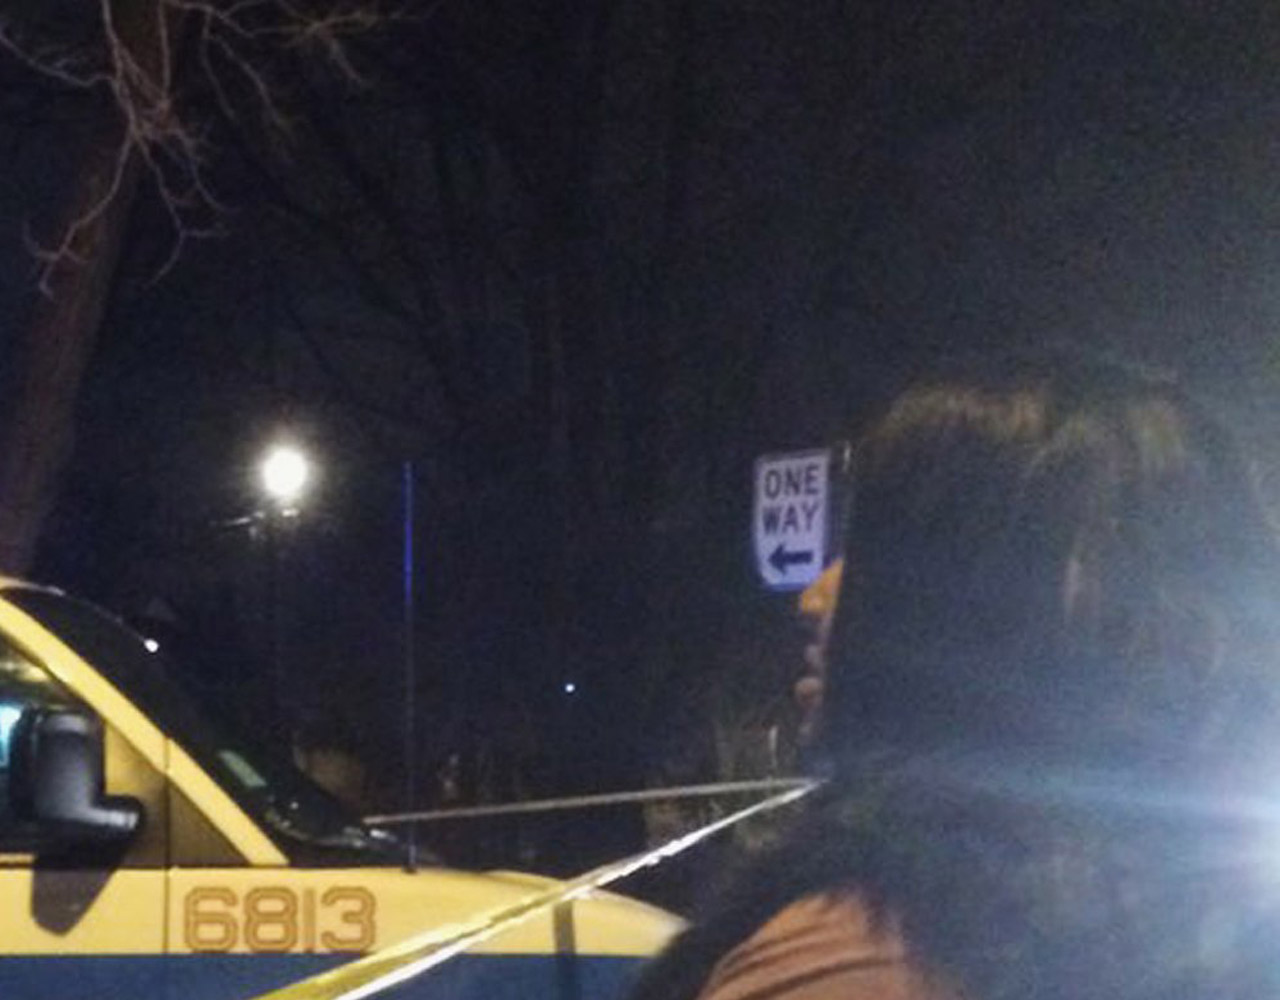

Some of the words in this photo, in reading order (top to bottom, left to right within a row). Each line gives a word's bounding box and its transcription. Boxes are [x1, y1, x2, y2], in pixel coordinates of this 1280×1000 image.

[765, 464, 818, 499] ONE
[763, 501, 818, 533] WAY
[183, 886, 377, 954] 6813
